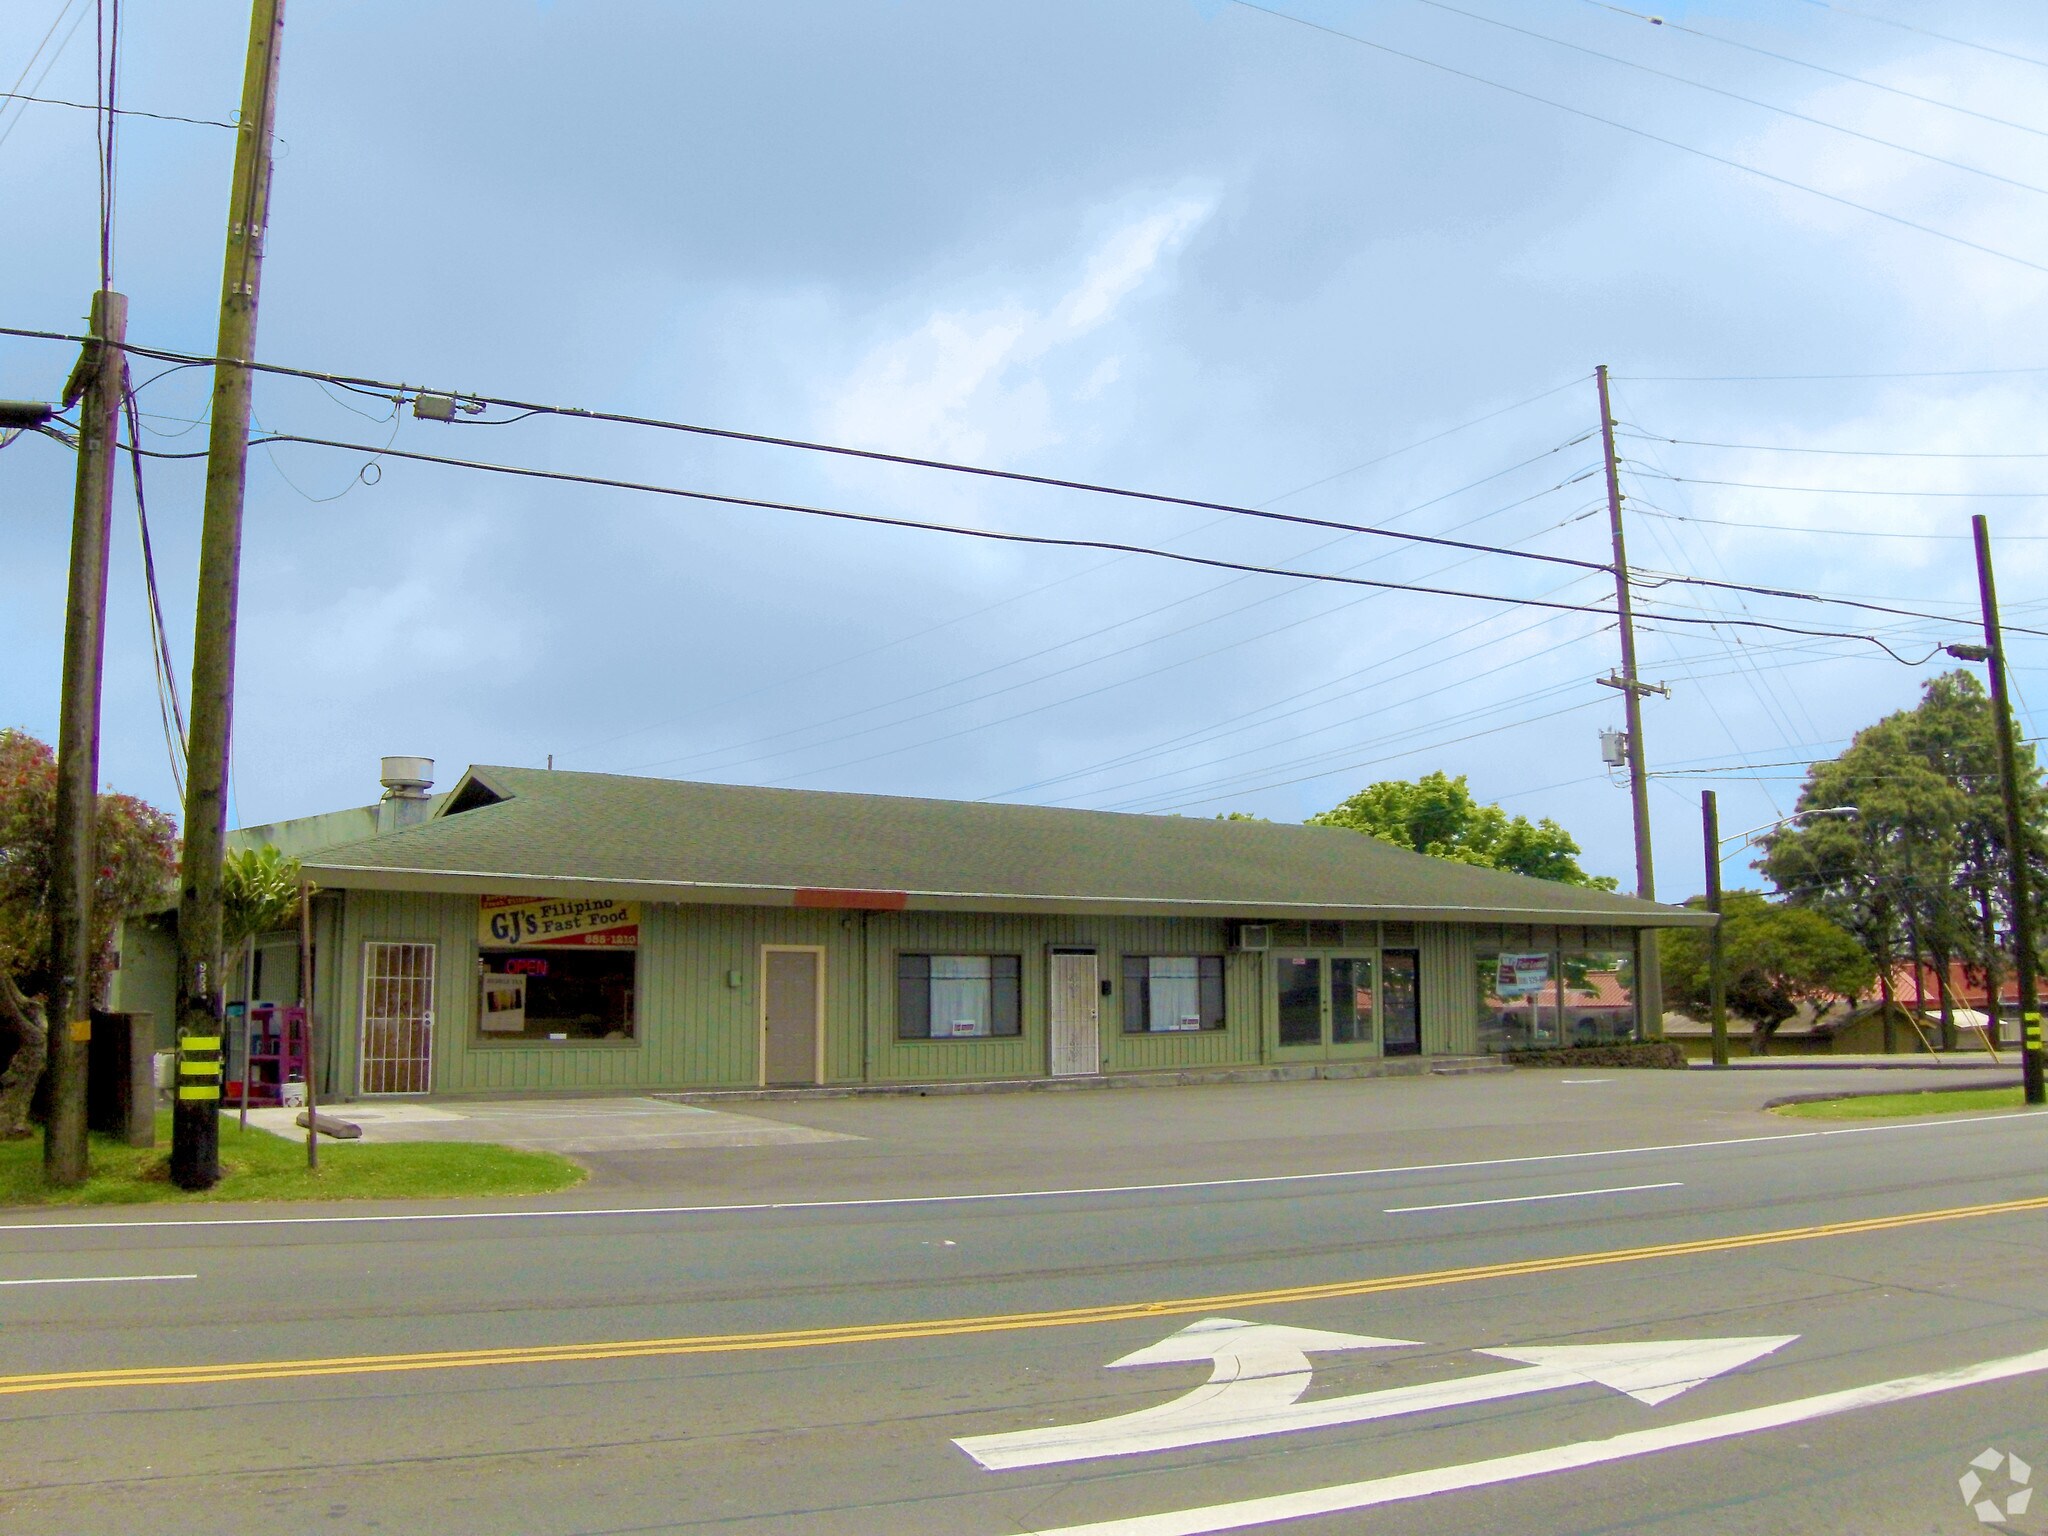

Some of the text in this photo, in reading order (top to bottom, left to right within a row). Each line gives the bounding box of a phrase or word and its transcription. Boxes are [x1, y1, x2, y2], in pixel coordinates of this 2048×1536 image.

[540, 899, 613, 918] Filipino
[492, 910, 537, 944] GJ's
[543, 909, 628, 933] Fast Food
[506, 959, 546, 975] OPEN
